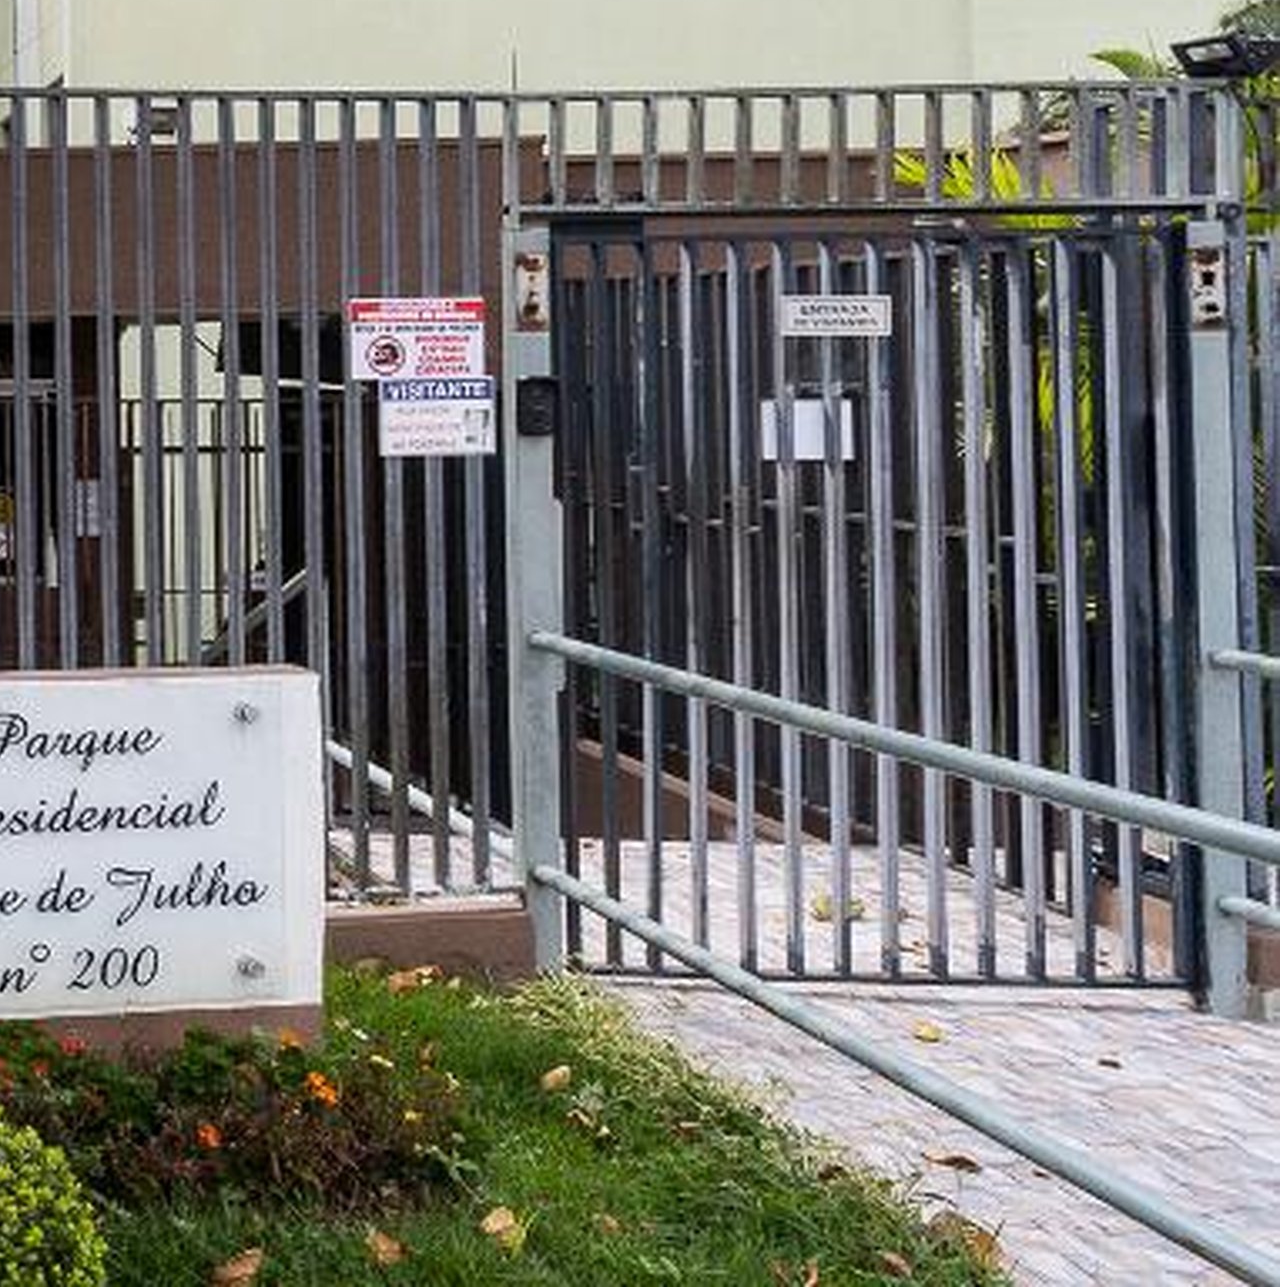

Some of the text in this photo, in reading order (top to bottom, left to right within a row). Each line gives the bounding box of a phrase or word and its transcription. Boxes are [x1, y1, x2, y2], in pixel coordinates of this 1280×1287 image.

[386, 382, 488, 399] VISITANTE
[36, 869, 96, 913] de
[106, 861, 269, 926] Julho
[66, 944, 160, 990] 200
